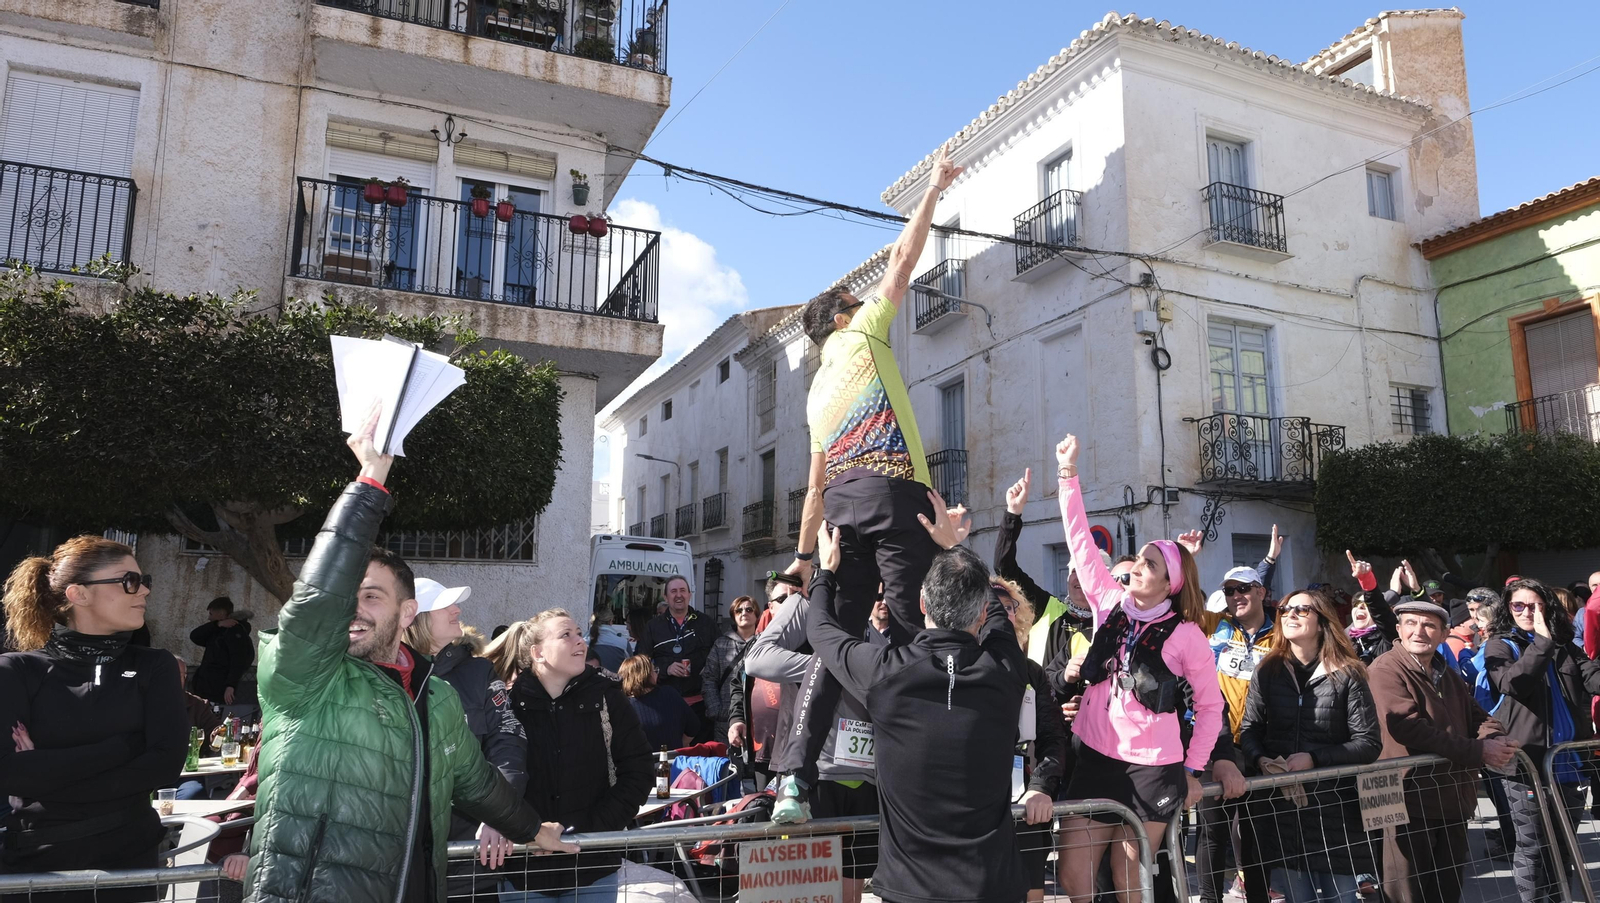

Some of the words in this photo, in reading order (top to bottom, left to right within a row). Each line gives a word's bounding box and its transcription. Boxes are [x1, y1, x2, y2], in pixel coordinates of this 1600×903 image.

[608, 560, 679, 573] AMBULANCIA
[802, 688, 812, 708] NON
[796, 709, 806, 736] STOP
[848, 735, 874, 756] 372
[1362, 775, 1388, 791] ALYSER
[1389, 773, 1399, 787] DE
[1360, 792, 1403, 810] MAQUINARIA
[1372, 816, 1383, 827] 950
[1384, 814, 1394, 824] 453
[1395, 812, 1406, 822] 550
[748, 843, 808, 864] ALYSER
[811, 840, 832, 859] DE
[740, 866, 839, 889] MAQUINARIA
